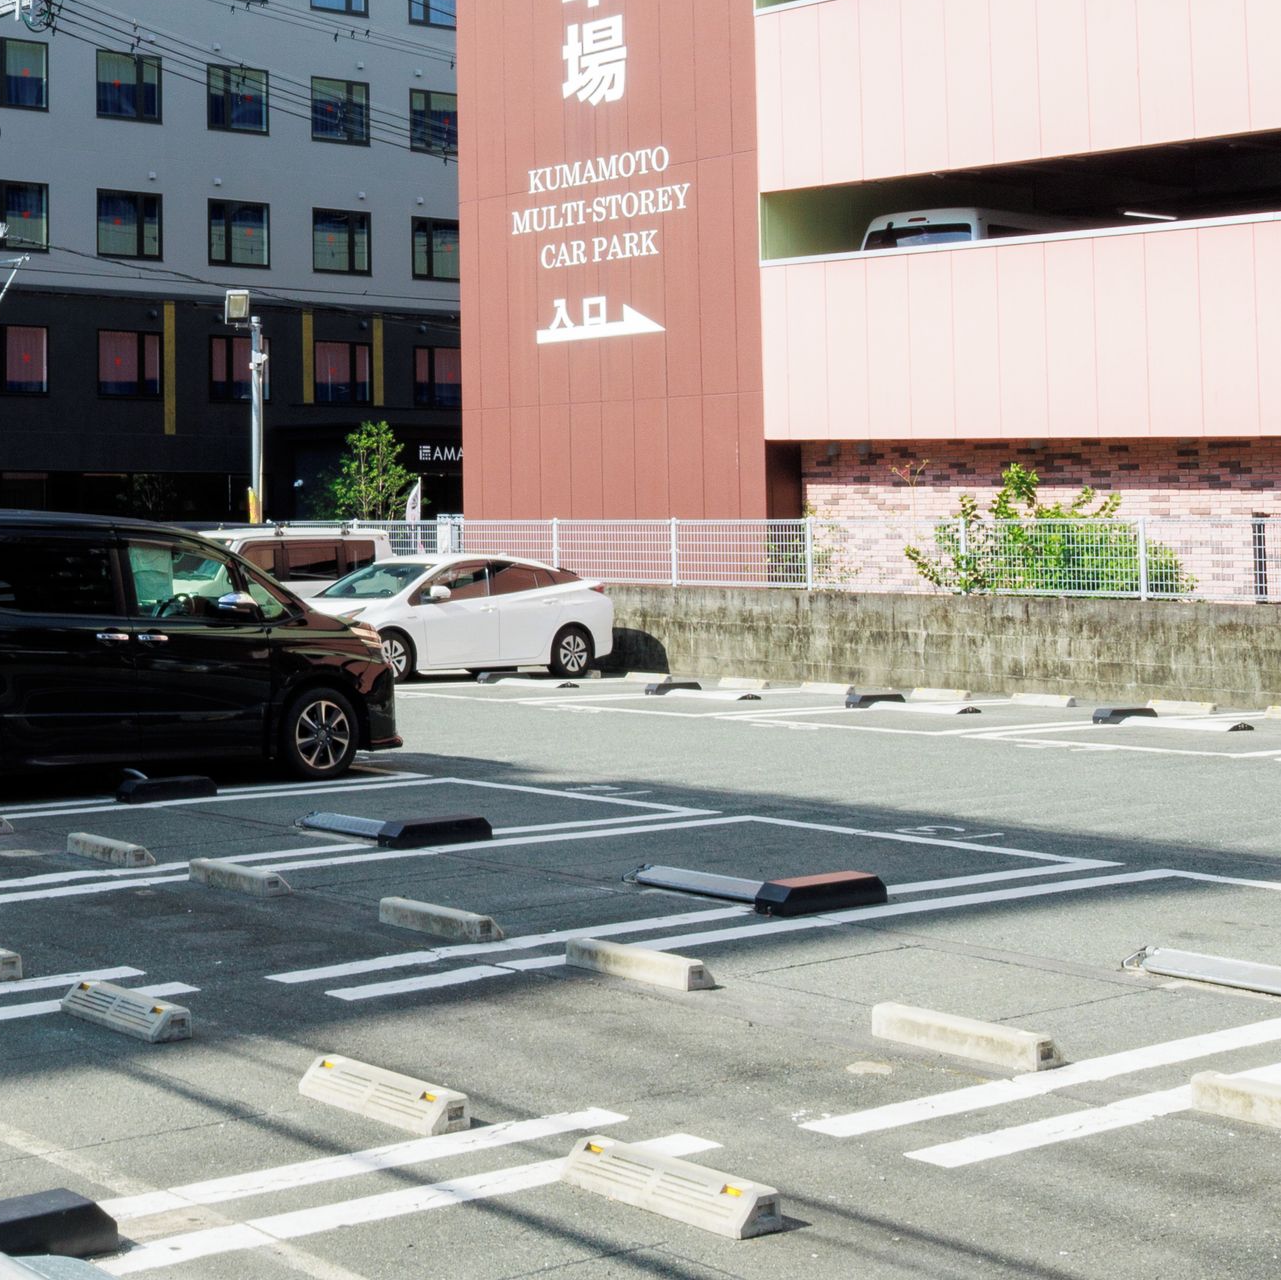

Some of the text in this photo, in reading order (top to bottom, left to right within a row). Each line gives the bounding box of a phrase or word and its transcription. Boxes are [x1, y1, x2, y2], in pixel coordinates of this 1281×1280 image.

[528, 145, 670, 194] KUMAMOTO
[511, 182, 691, 235] MULTI-STOREY
[540, 229, 659, 269] CAR PARK
[549, 296, 607, 329] 入口
